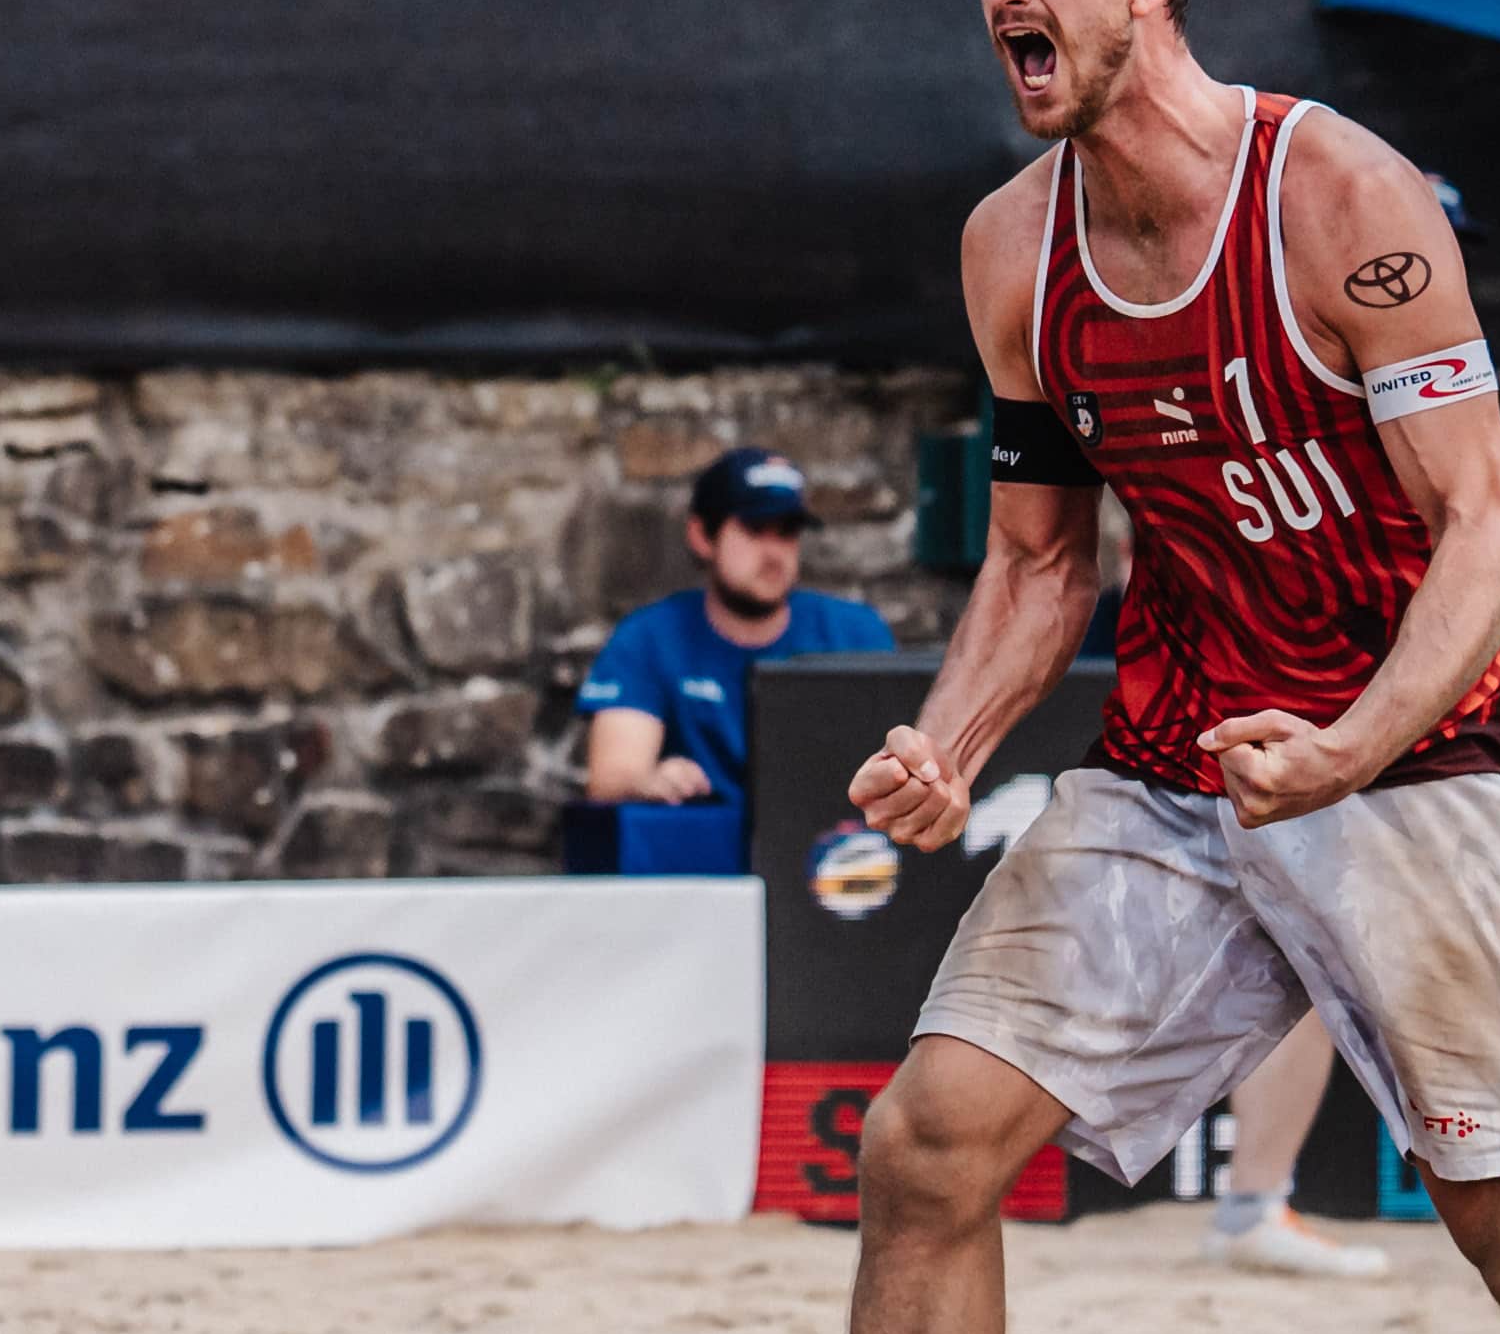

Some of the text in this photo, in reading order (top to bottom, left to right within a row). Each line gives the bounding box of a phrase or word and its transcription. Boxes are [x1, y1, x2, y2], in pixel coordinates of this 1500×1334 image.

[1224, 356, 1267, 445] 1
[1371, 370, 1432, 395] UNITED
[1160, 428, 1200, 446] nine
[1221, 438, 1357, 543] SUI
